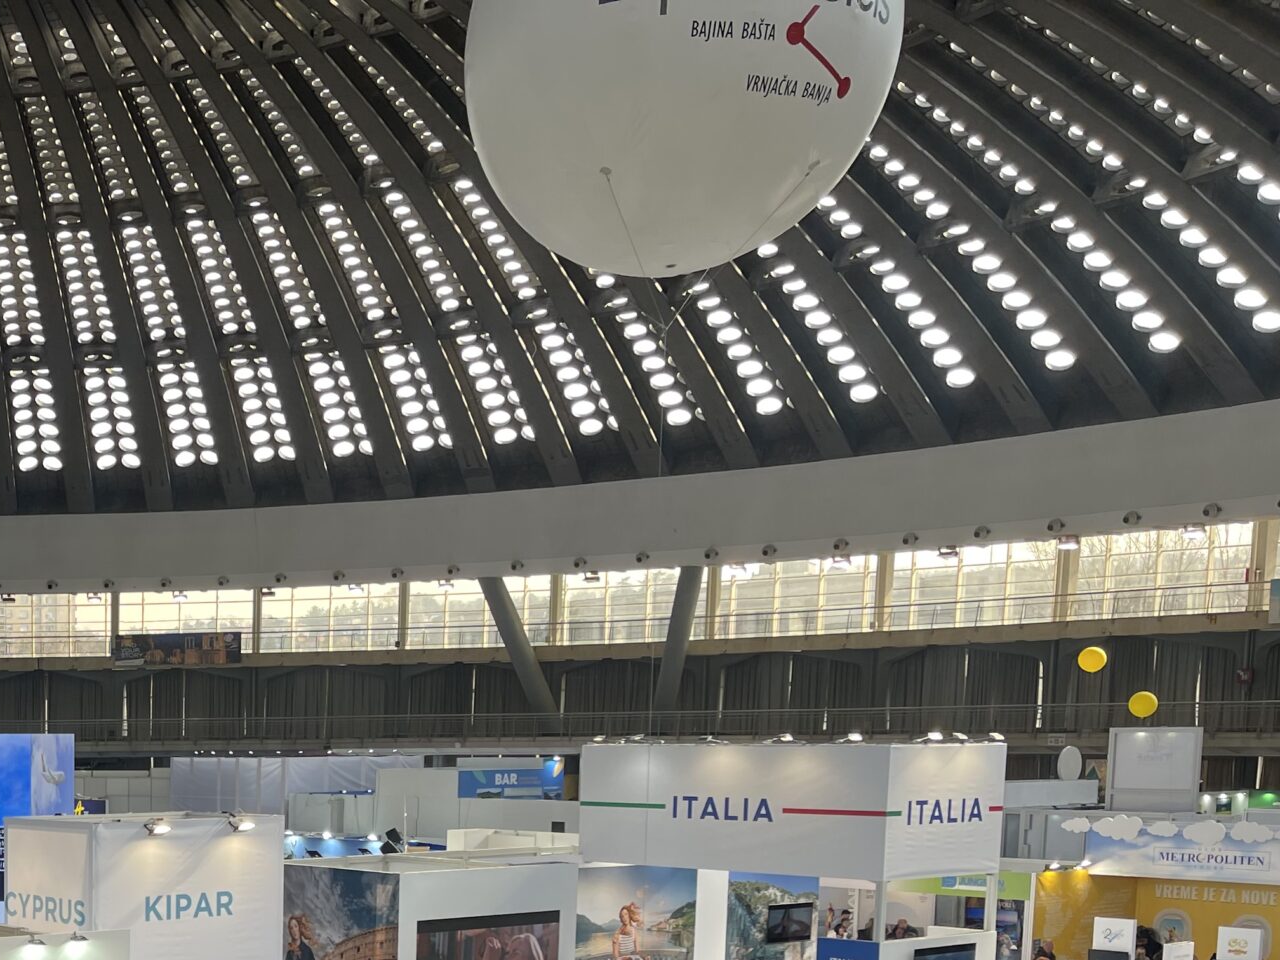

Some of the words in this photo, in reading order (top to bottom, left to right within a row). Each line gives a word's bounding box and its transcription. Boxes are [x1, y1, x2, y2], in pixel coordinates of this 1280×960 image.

[691, 20, 733, 41] BAJINA
[741, 18, 776, 41] BAŠTA
[746, 73, 797, 98] VRNJAČKA
[801, 82, 832, 105] BANJA
[495, 773, 518, 785] BAR
[672, 796, 774, 823] ITALIA
[907, 797, 984, 825] ITALIA
[144, 890, 234, 922] KIPAR
[1155, 883, 1199, 900] VREME
[1202, 888, 1218, 901] JE
[1221, 888, 1237, 903] ZA
[1241, 890, 1278, 906] NOVE
[5, 891, 86, 927] CYPRUS
